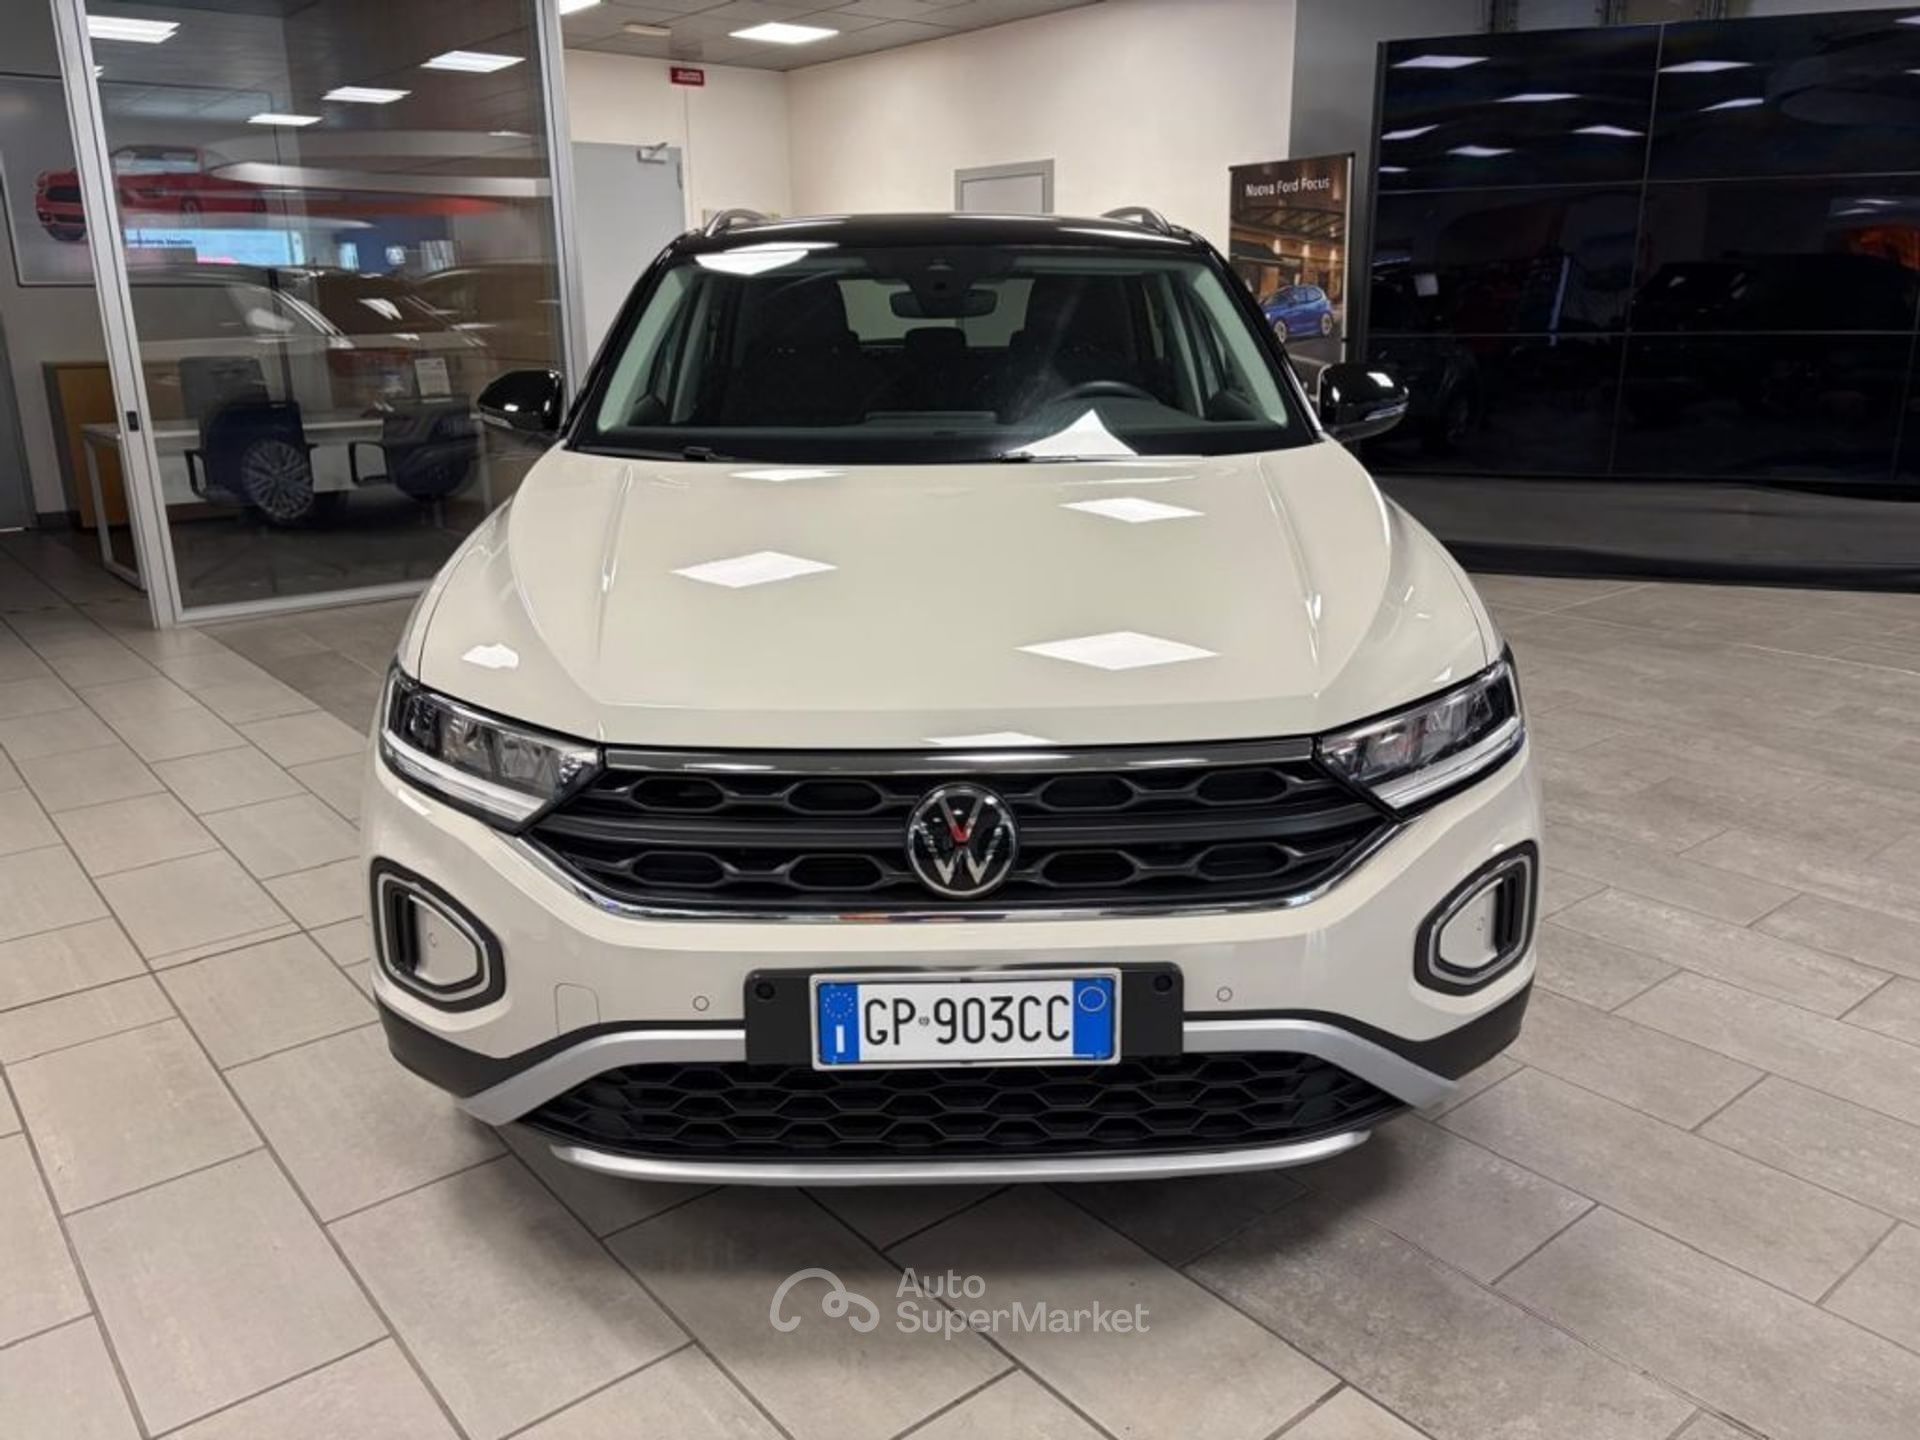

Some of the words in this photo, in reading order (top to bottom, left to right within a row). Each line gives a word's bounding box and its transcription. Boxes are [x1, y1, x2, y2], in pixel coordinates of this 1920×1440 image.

[1245, 183, 1275, 197] Nuova
[1277, 179, 1299, 194] Ford
[1301, 177, 1330, 191] Focus
[909, 786, 1014, 893] VW
